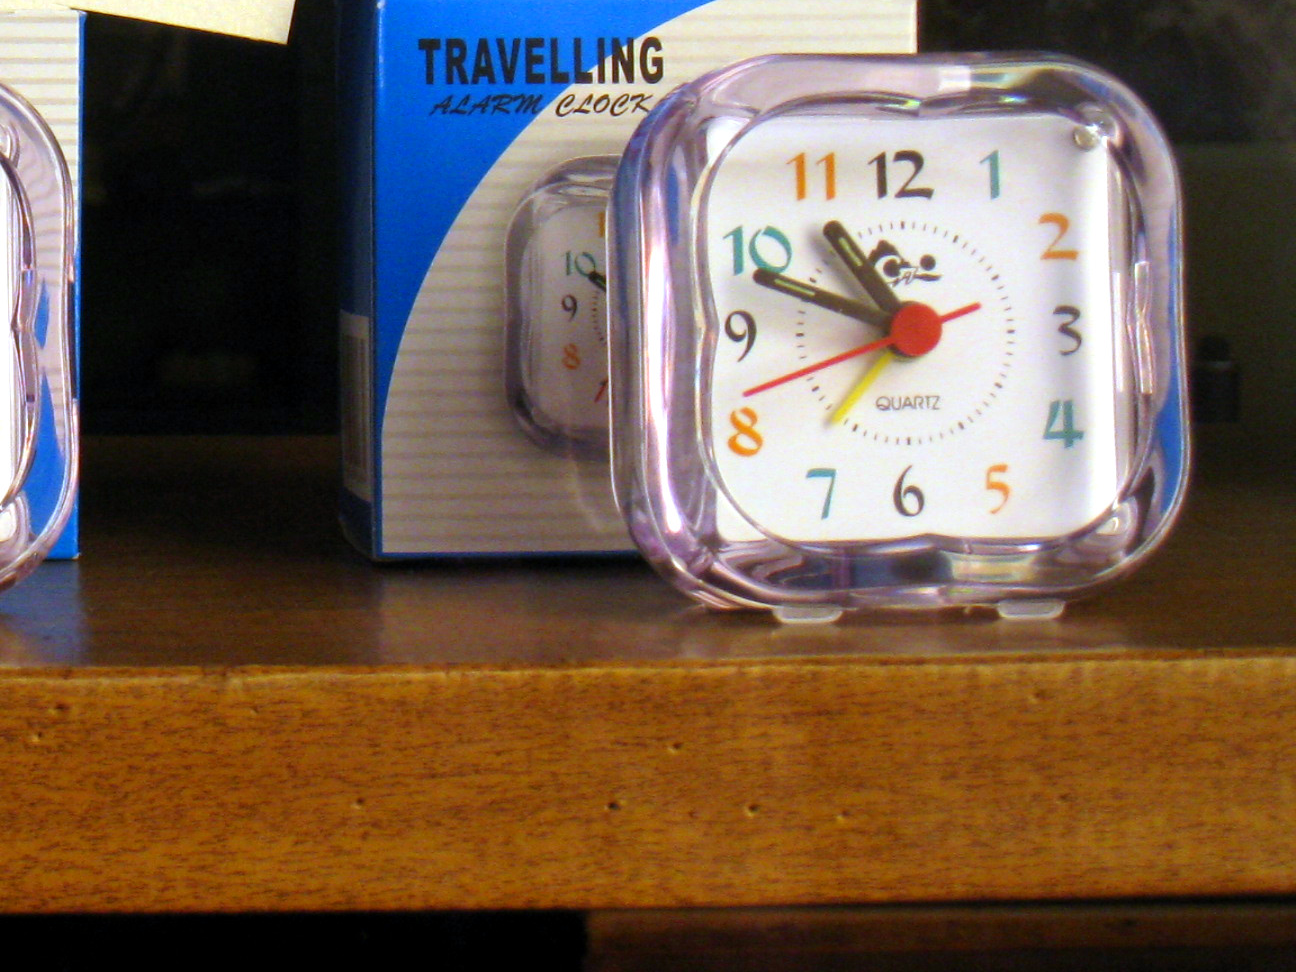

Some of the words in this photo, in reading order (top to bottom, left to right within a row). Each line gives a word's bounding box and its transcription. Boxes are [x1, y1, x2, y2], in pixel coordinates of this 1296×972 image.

[418, 37, 664, 84] TRAVELLING
[429, 94, 543, 116] ALARM
[555, 93, 654, 117] CLOCK
[785, 151, 836, 201] 11
[868, 149, 934, 199] 12
[979, 149, 1000, 199] 1
[722, 225, 793, 276] 10
[1038, 212, 1078, 261] 2
[561, 294, 578, 322] 9
[1052, 306, 1082, 356] 3
[561, 343, 581, 370] 8
[724, 309, 756, 362] 9
[876, 395, 940, 412] QUARTZ
[1043, 399, 1083, 449] 4
[727, 407, 763, 457] 8
[806, 468, 837, 519] 7
[893, 464, 925, 517] 6
[985, 464, 1010, 514] 5
